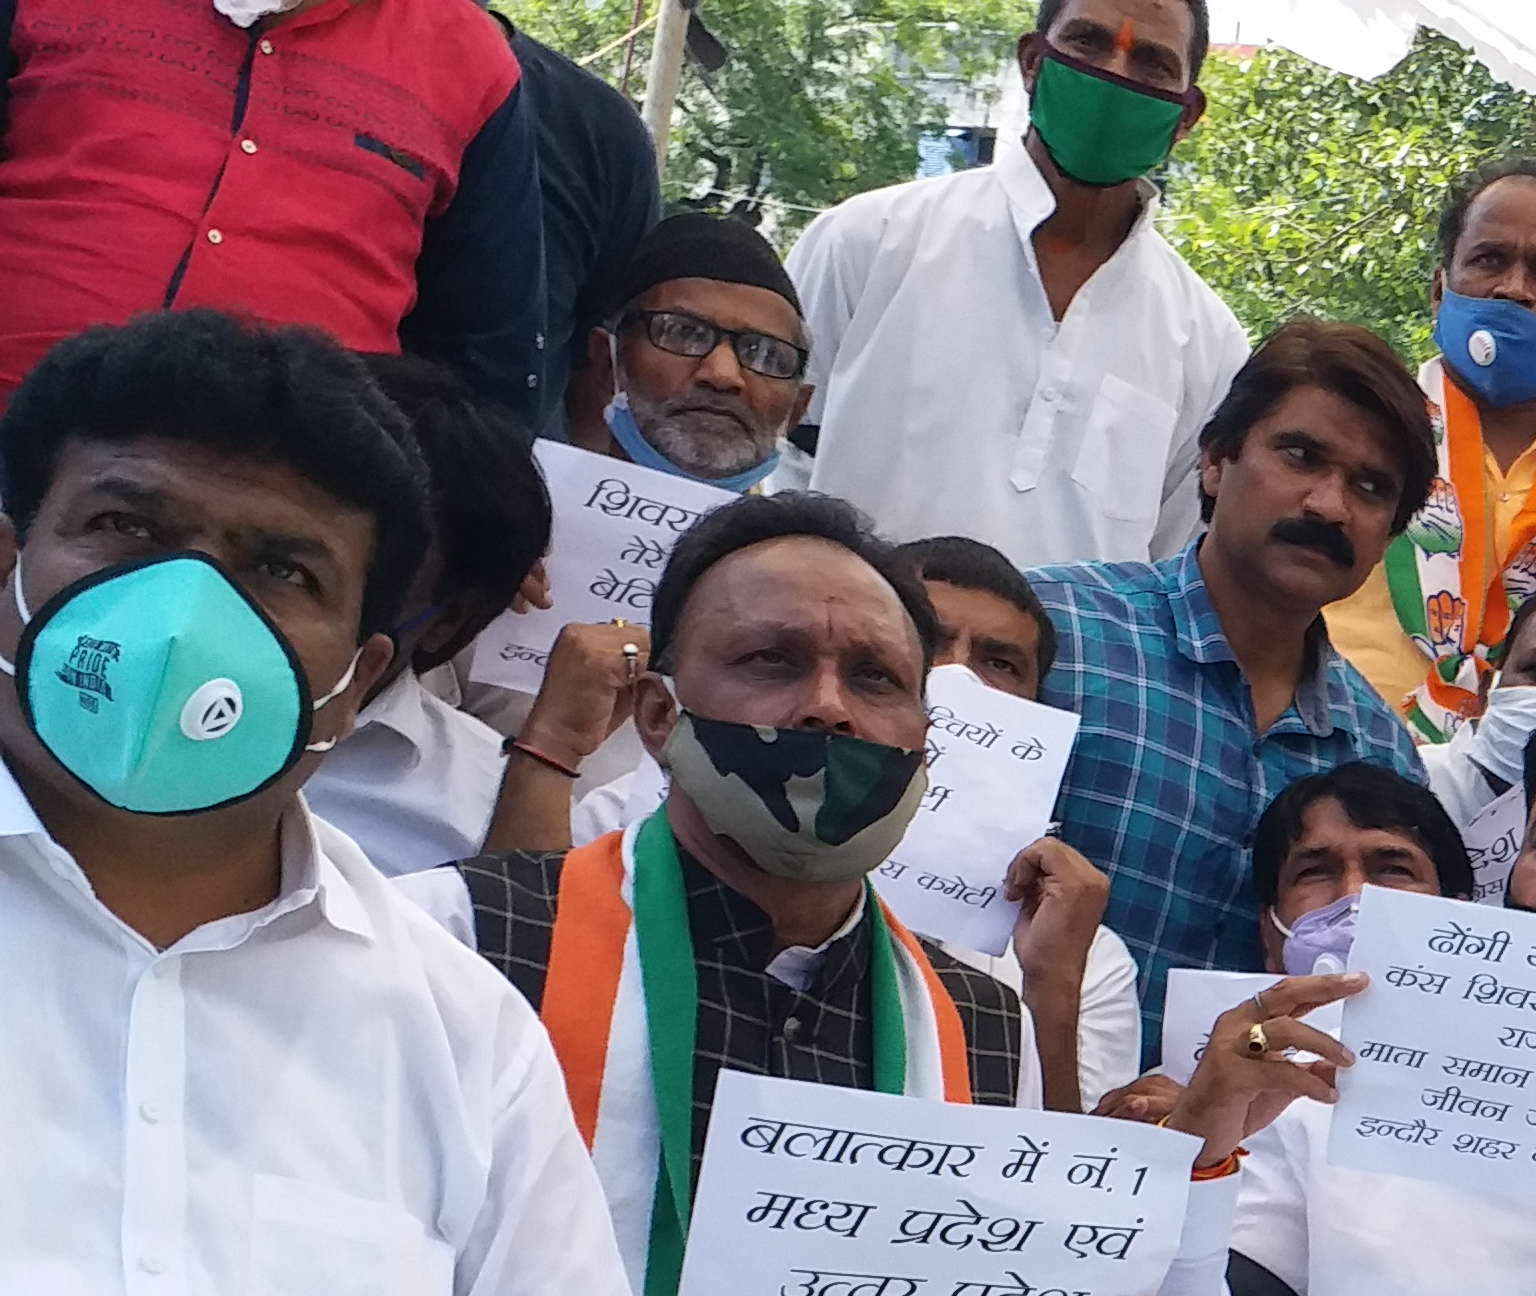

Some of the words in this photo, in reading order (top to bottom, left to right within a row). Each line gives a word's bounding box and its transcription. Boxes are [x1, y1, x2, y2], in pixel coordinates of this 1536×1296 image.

[589, 568, 657, 609] बेटि
[69, 646, 111, 680] PRIDE
[1010, 737, 1047, 761] के
[917, 870, 997, 909] कमेटी
[1427, 921, 1512, 963] ढोंगी
[1384, 964, 1451, 996] कंस
[1359, 1040, 1429, 1070] माता
[1442, 1054, 1533, 1088] समान
[1421, 1085, 1512, 1122] जीवन
[739, 1116, 985, 1178] बलात्कार
[1002, 1134, 1049, 1185] में
[1355, 1114, 1442, 1147] इन्दौर
[1452, 1133, 1521, 1162] शहर
[745, 1191, 877, 1238] मध्य
[891, 1199, 1044, 1254] प्रदेश
[1064, 1216, 1145, 1261] एवं
